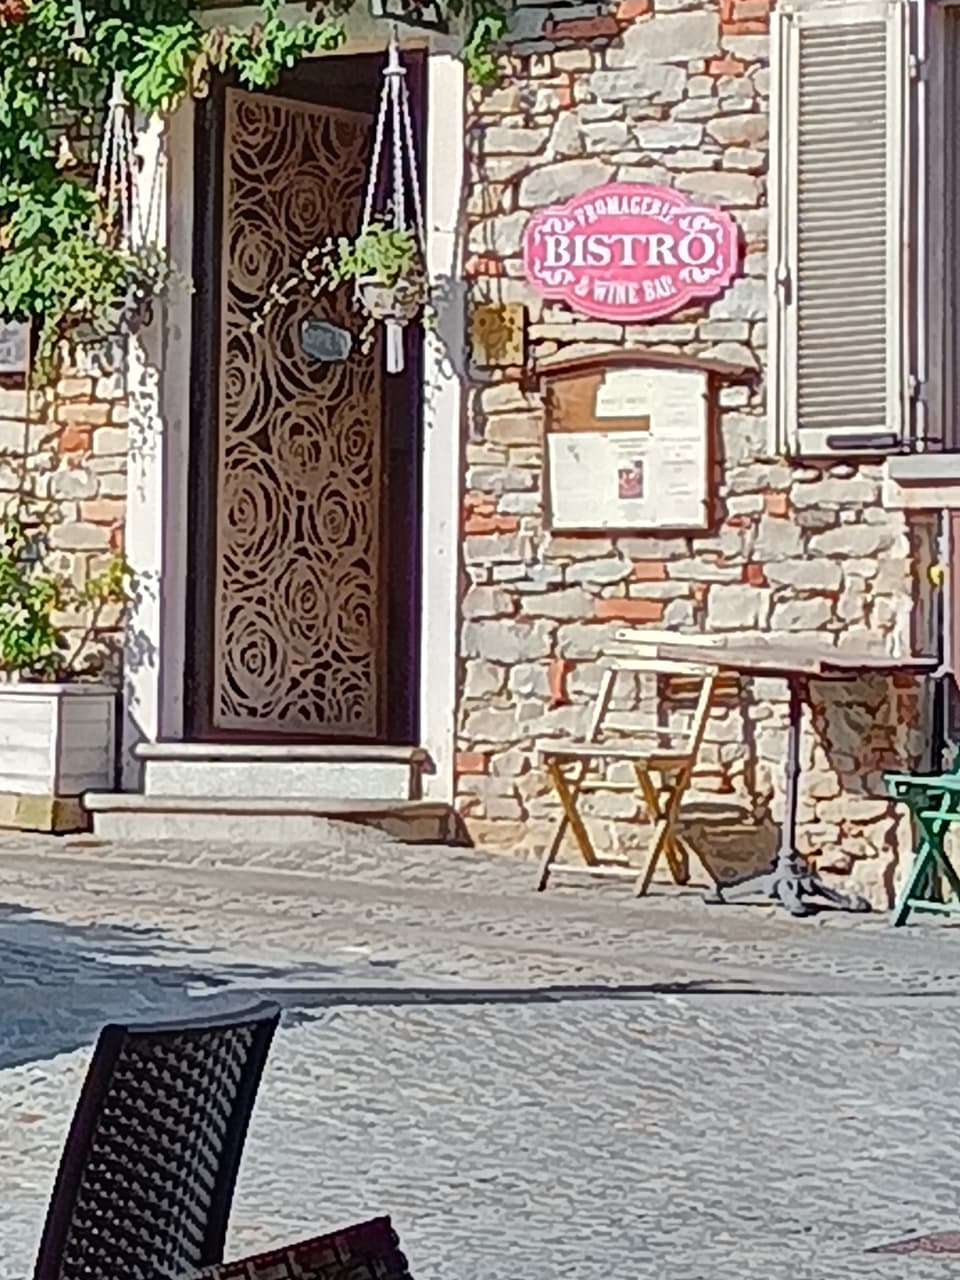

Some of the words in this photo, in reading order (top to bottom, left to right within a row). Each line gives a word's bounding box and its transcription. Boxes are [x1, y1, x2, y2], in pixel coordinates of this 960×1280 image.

[574, 195, 680, 227] FROMAGERIE
[592, 279, 640, 306] WINE
[644, 275, 677, 302] BAR
